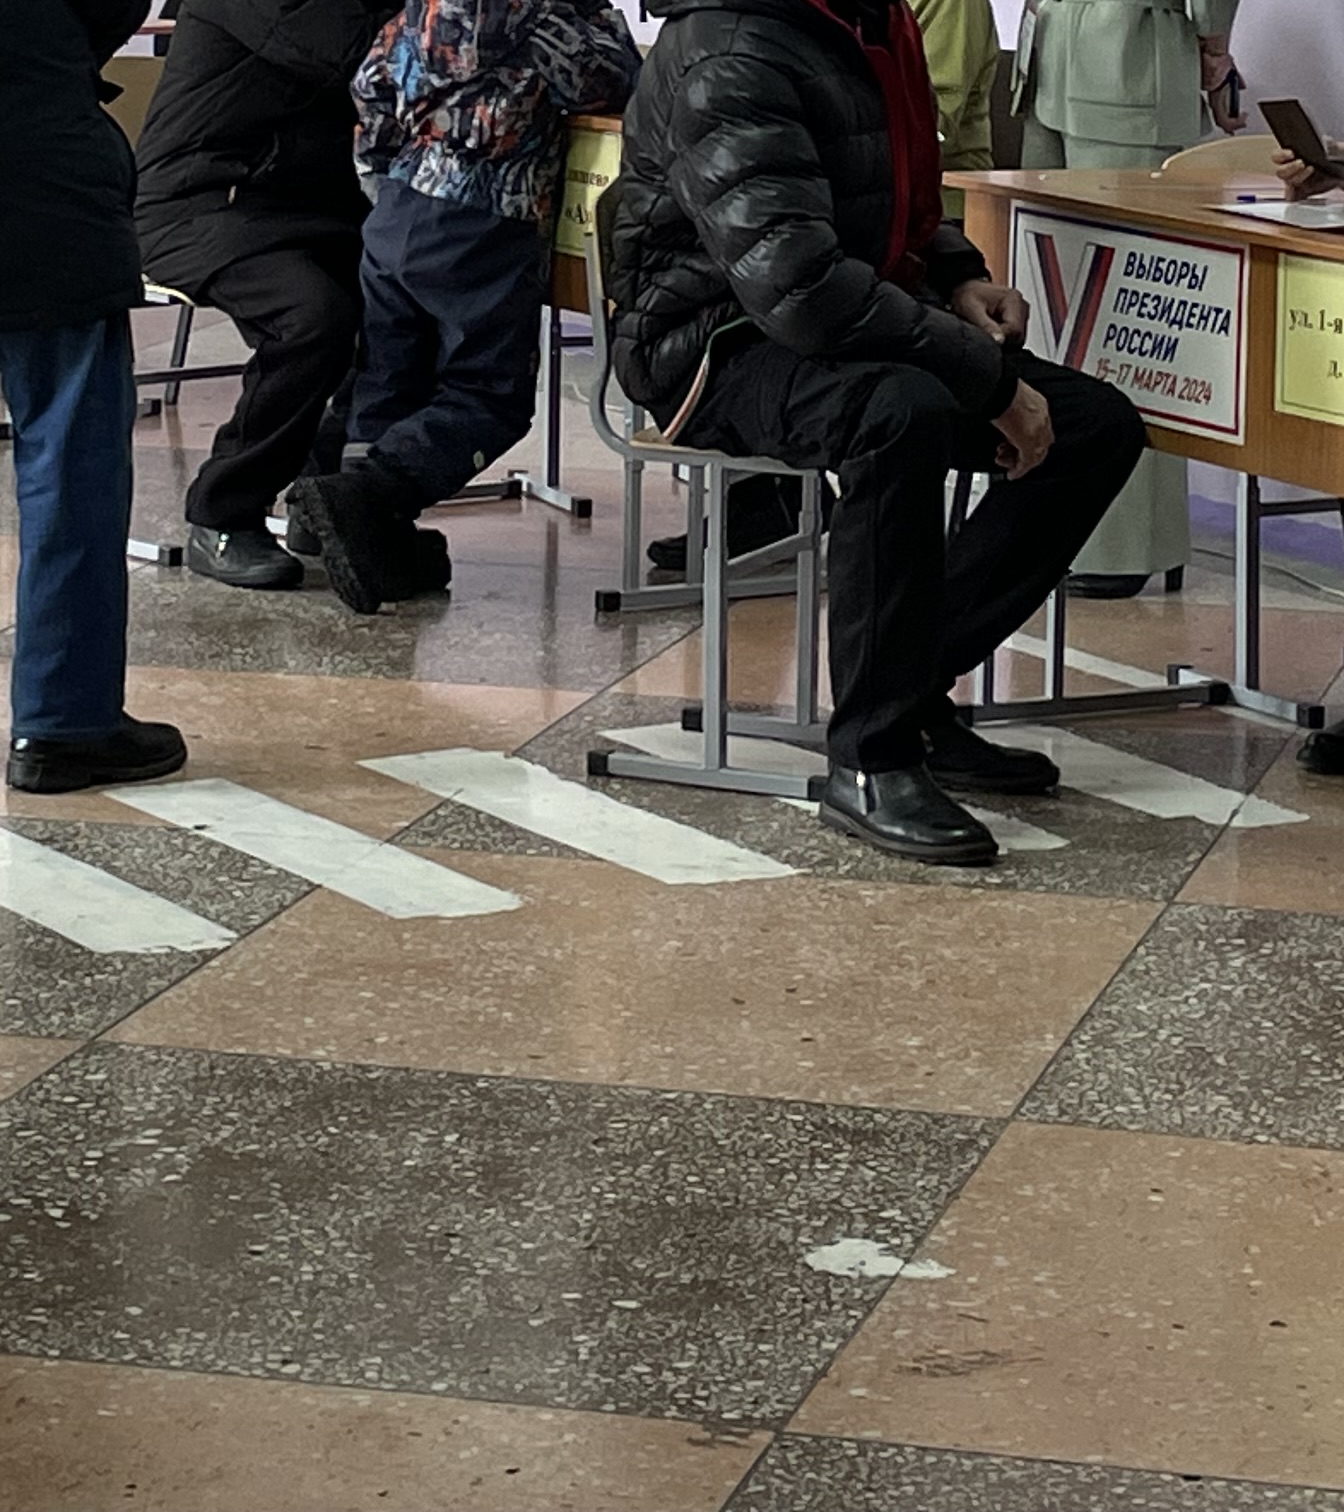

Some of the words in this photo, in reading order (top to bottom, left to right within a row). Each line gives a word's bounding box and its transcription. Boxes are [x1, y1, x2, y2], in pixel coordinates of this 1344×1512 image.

[1122, 250, 1209, 292] ВЫБОРЫ
[1112, 286, 1232, 337] ПРЕЗИДЕНТА
[1102, 322, 1180, 364] РОССИИ
[1130, 365, 1177, 398] МАРТА
[1177, 376, 1213, 406] 2024
